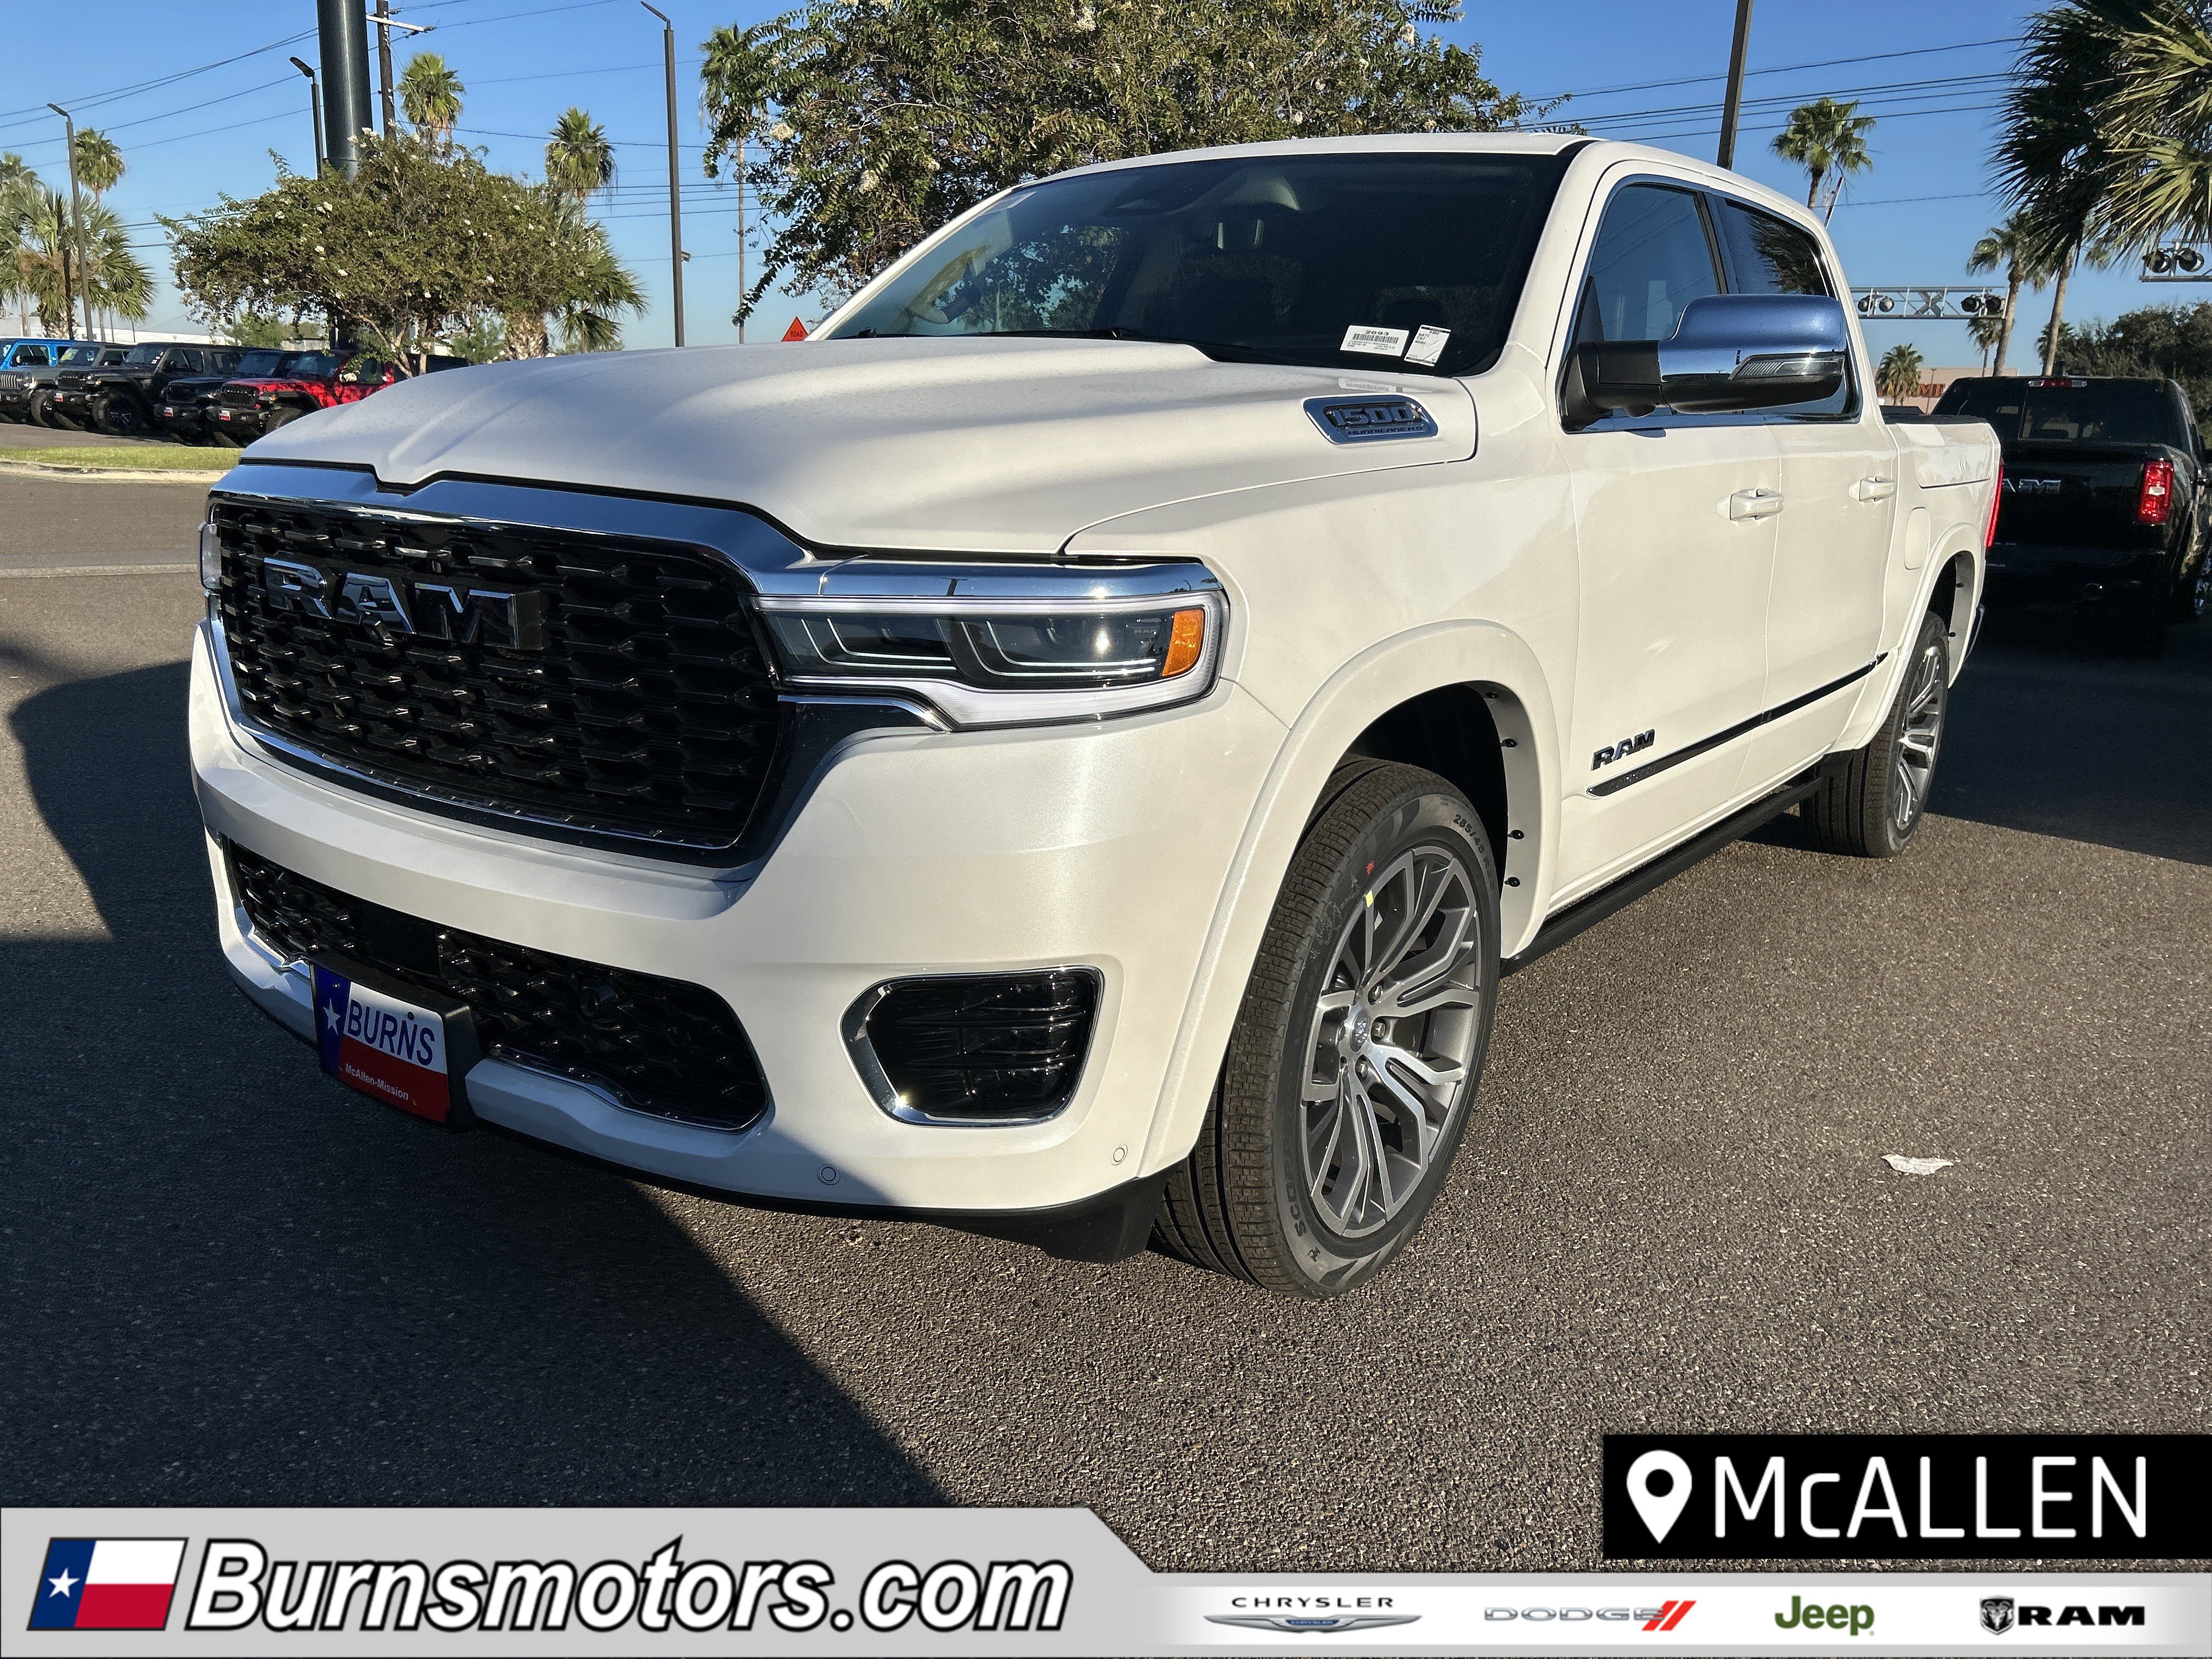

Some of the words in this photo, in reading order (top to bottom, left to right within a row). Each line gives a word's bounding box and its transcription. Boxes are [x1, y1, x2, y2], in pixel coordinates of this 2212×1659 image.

[1327, 407, 1415, 426] 1500
[1348, 427, 1406, 435] HURRICANE
[2002, 478, 2061, 494] AM
[264, 557, 520, 650] RAM
[1590, 729, 1655, 771] RAM
[347, 999, 435, 1066] BURNS
[345, 1063, 409, 1101] McAllen-Mission
